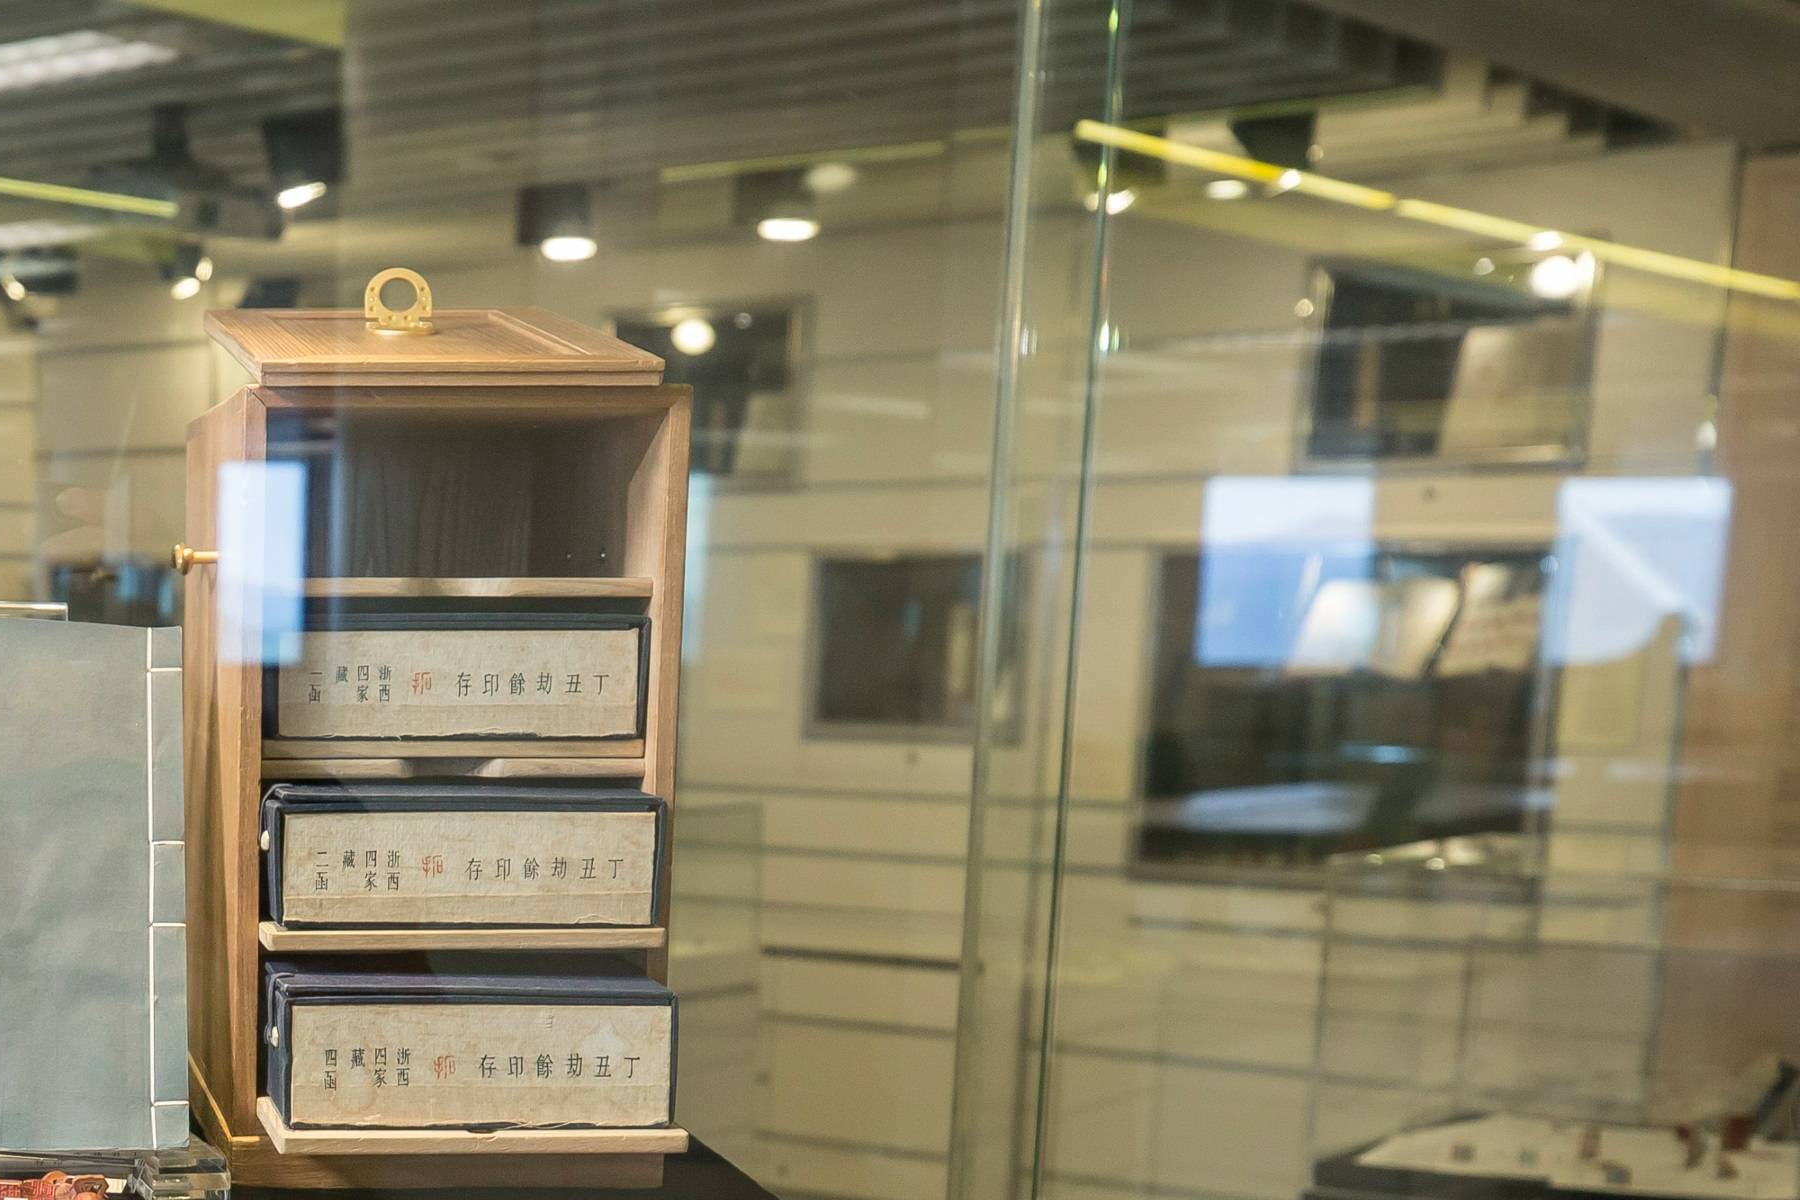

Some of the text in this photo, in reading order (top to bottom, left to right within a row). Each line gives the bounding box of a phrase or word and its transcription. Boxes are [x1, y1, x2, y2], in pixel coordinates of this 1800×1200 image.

[456, 671, 609, 698] 丁丑劫餘印存
[465, 857, 624, 881] 丁丑劫餘印存
[479, 1053, 640, 1079] 丁丑劫餘印存
